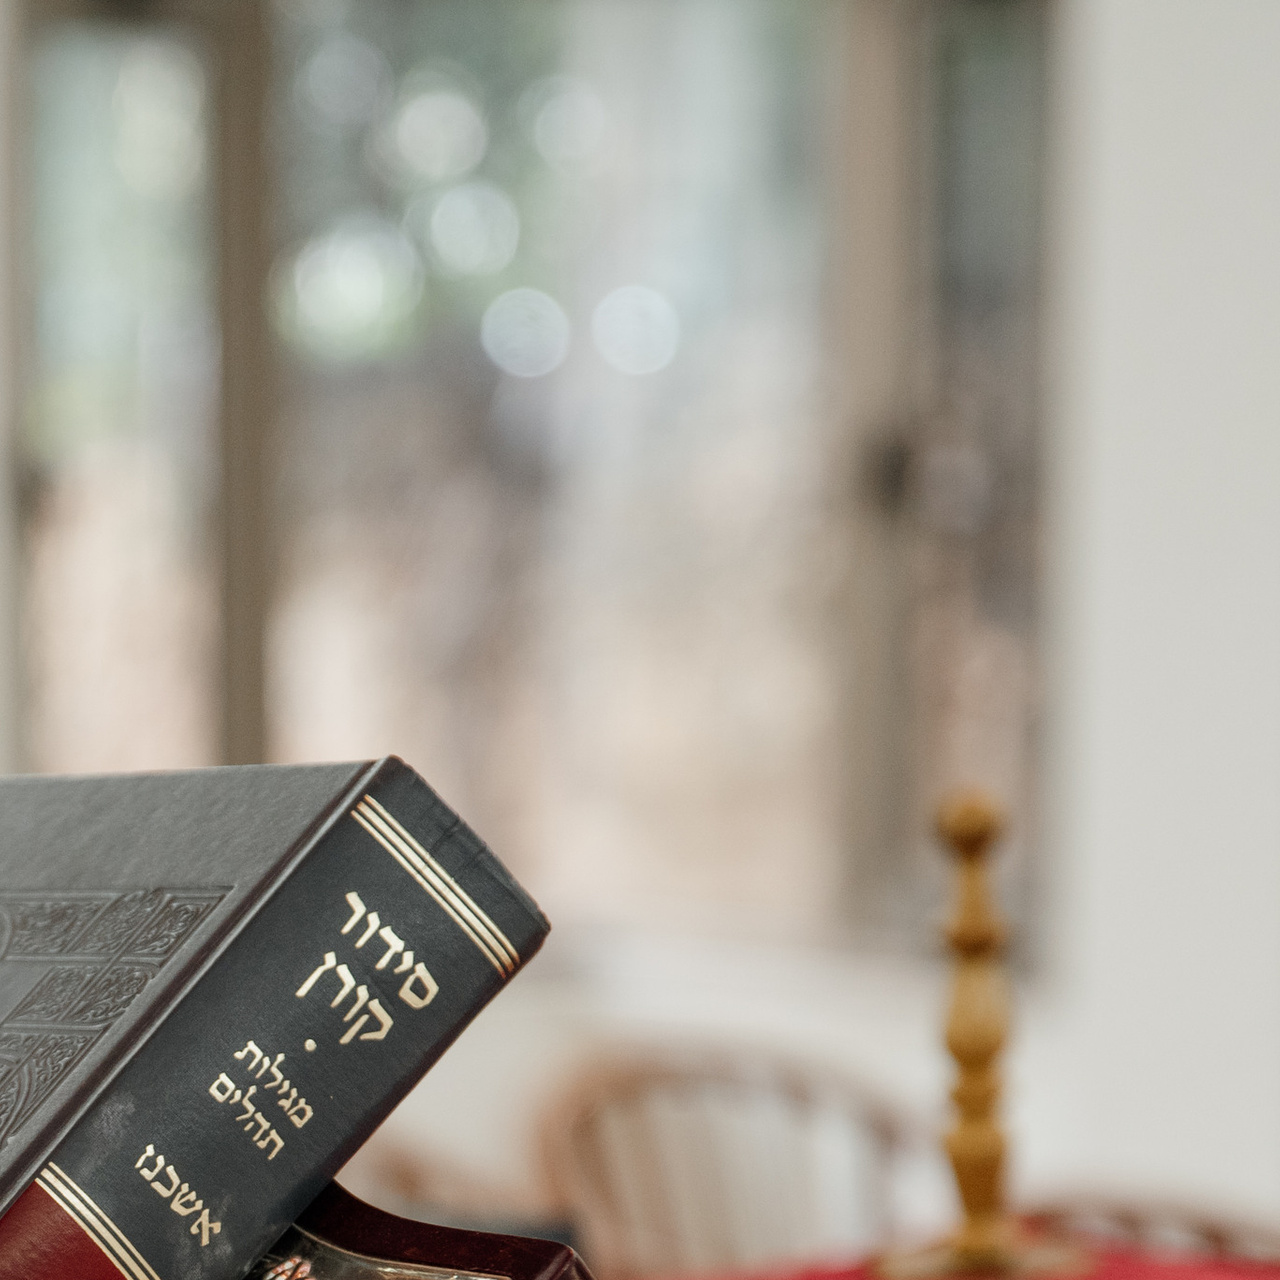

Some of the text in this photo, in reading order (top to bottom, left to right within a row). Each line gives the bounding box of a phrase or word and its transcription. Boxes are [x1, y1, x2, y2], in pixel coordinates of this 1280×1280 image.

[340, 891, 440, 1010] סידור
[294, 951, 394, 1045] קורן
[209, 1072, 285, 1161] תהלים
[233, 1040, 314, 1129] מגילות
[134, 1144, 222, 1247] אשכנז
